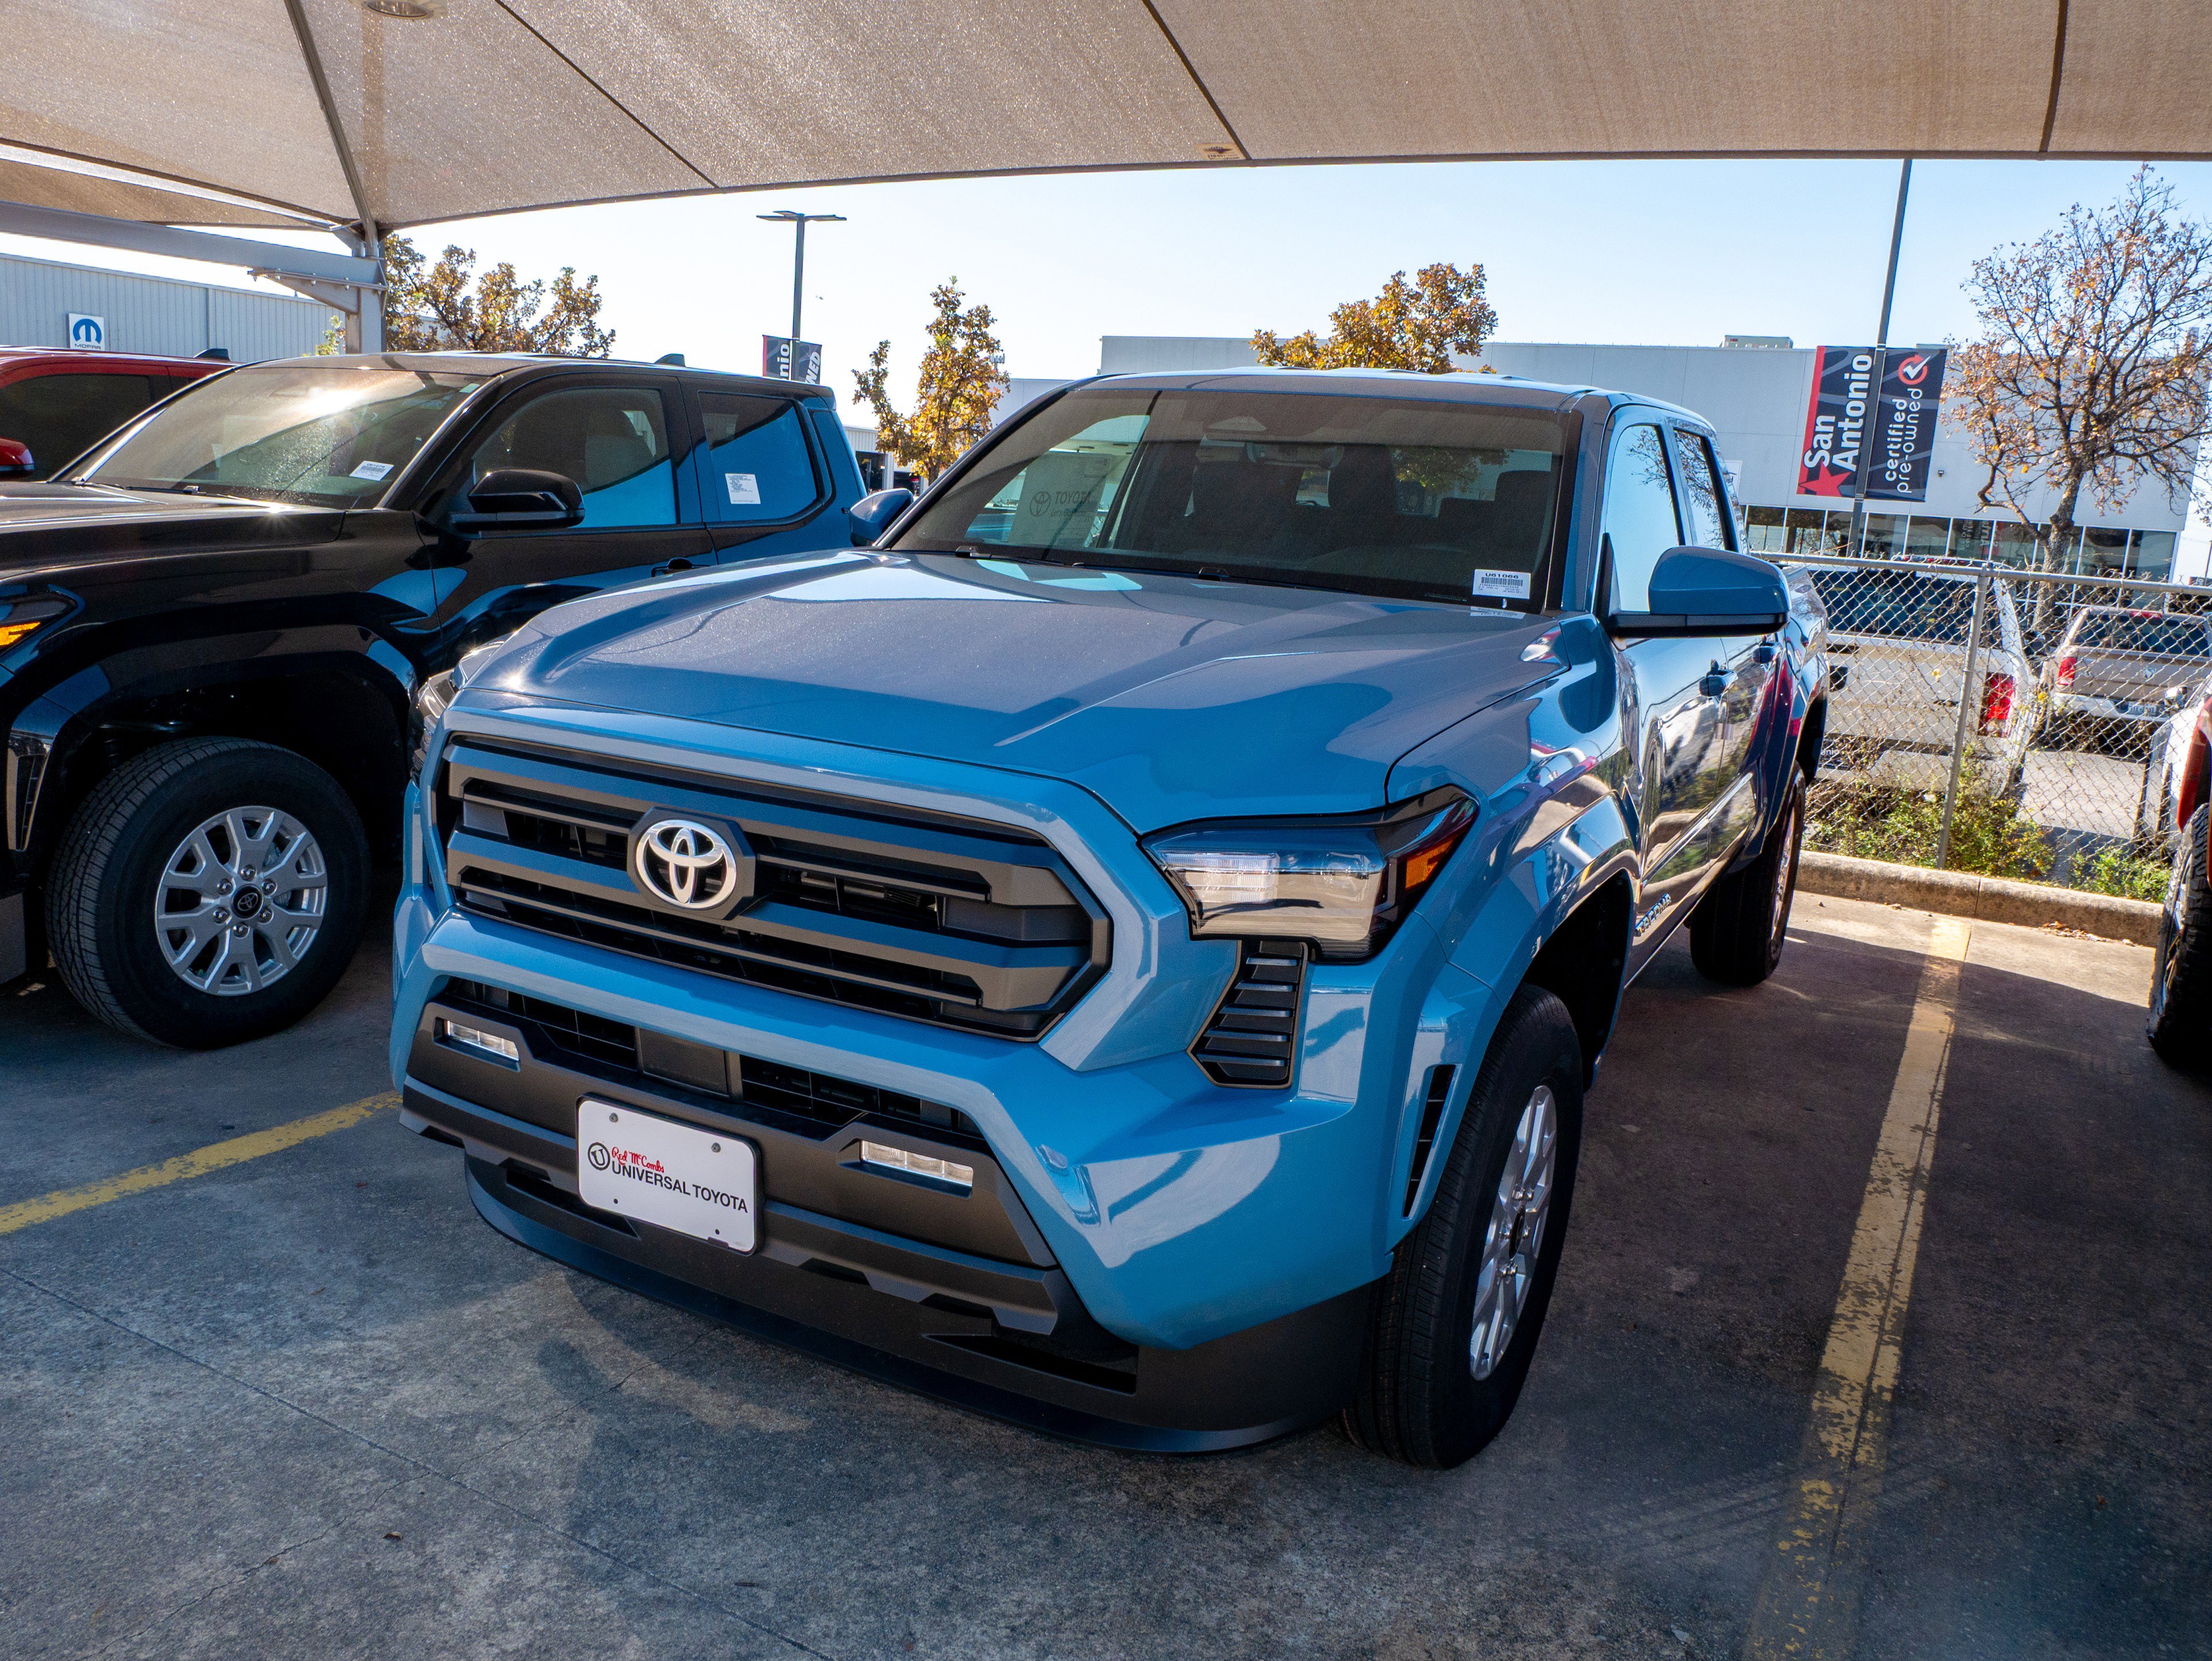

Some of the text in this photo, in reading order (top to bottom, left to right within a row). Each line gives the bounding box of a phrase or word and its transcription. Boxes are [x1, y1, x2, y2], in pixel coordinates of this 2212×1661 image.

[777, 344, 790, 380] nio
[1831, 355, 1872, 472] Antonio
[1804, 415, 1836, 468] San
[1885, 399, 1907, 482] certified
[1896, 388, 1922, 493] pre-owned
[1054, 491, 1090, 505] TOYOTA
[1634, 893, 1672, 937] TACOMA
[611, 1146, 665, 1174] Red McCombs
[612, 1160, 748, 1213] UNIVERSAL TOYOTA
